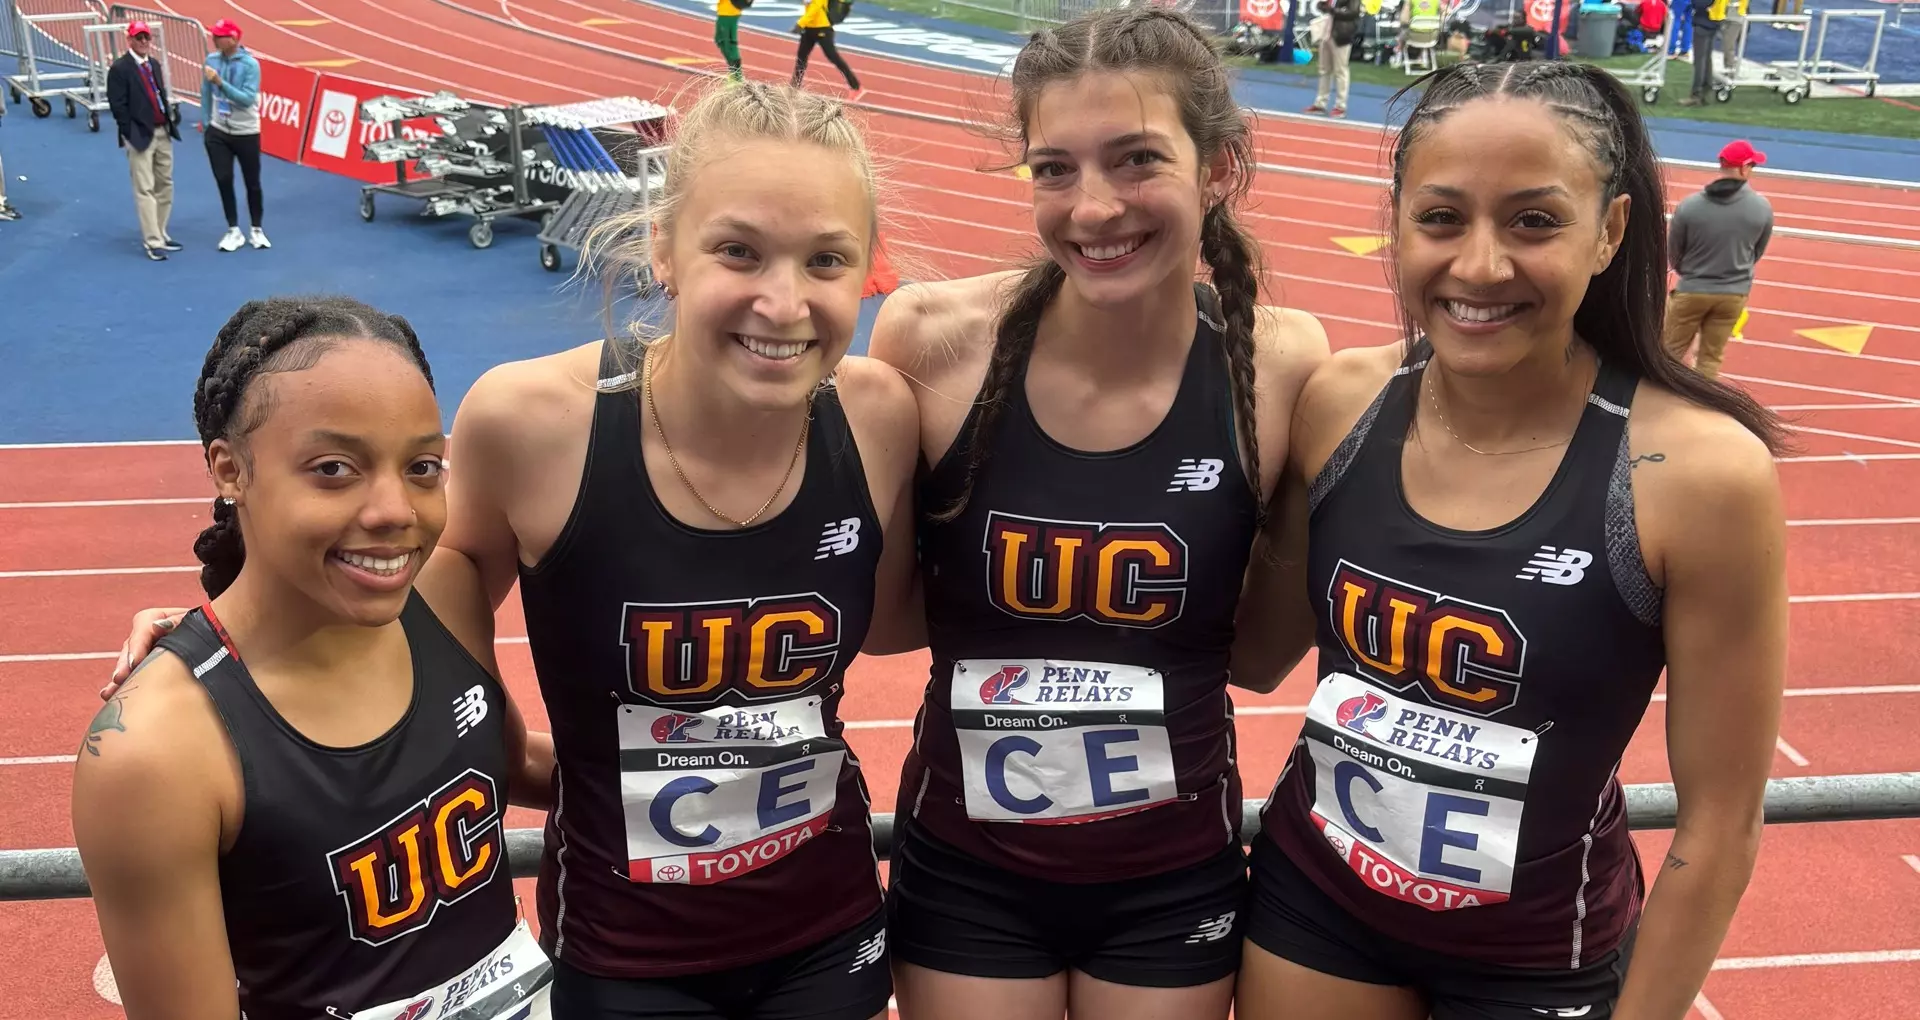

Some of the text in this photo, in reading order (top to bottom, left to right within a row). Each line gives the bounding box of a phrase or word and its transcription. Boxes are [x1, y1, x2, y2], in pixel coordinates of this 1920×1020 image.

[256, 91, 300, 129] YOTA
[988, 515, 1186, 626] UC
[630, 600, 836, 699] UC
[1330, 564, 1525, 714] UC
[1034, 685, 1134, 703] RELAYS
[1040, 666, 1111, 684] PENN
[984, 714, 1068, 728] Dream On.
[1387, 727, 1499, 770] RELAYS
[1395, 708, 1481, 743] PENN
[657, 751, 750, 767] Dream On.
[984, 729, 1151, 814] C E
[1333, 735, 1416, 779] Dream On.
[648, 758, 816, 847] C E
[1333, 760, 1491, 884] C E
[332, 772, 501, 942] UC
[697, 824, 814, 880] TOYOTA
[1358, 850, 1482, 908] TOYOTA
